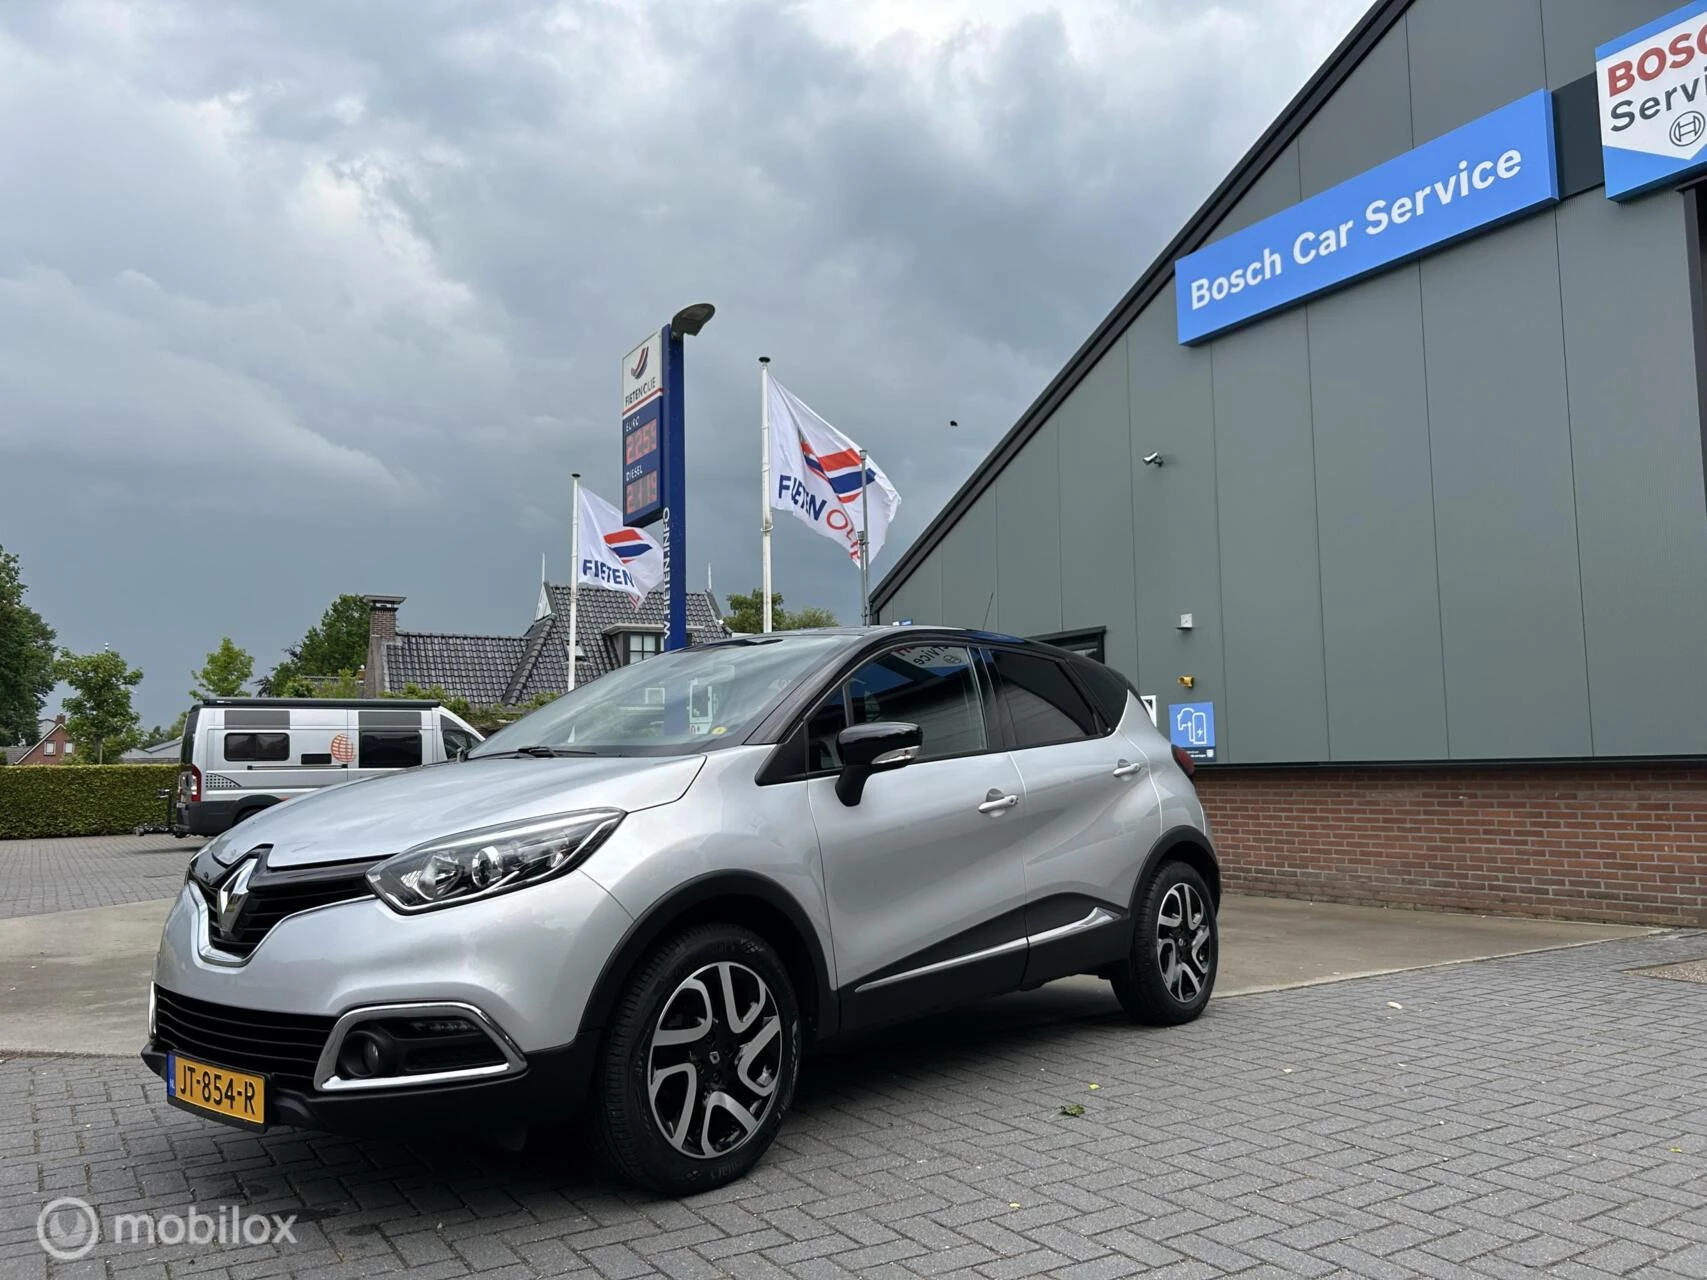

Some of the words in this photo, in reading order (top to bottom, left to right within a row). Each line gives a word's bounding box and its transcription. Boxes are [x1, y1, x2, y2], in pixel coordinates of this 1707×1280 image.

[1191, 247, 1282, 310] Bosch
[1293, 219, 1354, 265] Car
[1365, 149, 1522, 235] Service
[626, 464, 643, 482] DIESEL
[582, 559, 635, 587] FIETEN
[180, 1065, 255, 1115] JT-854-R
